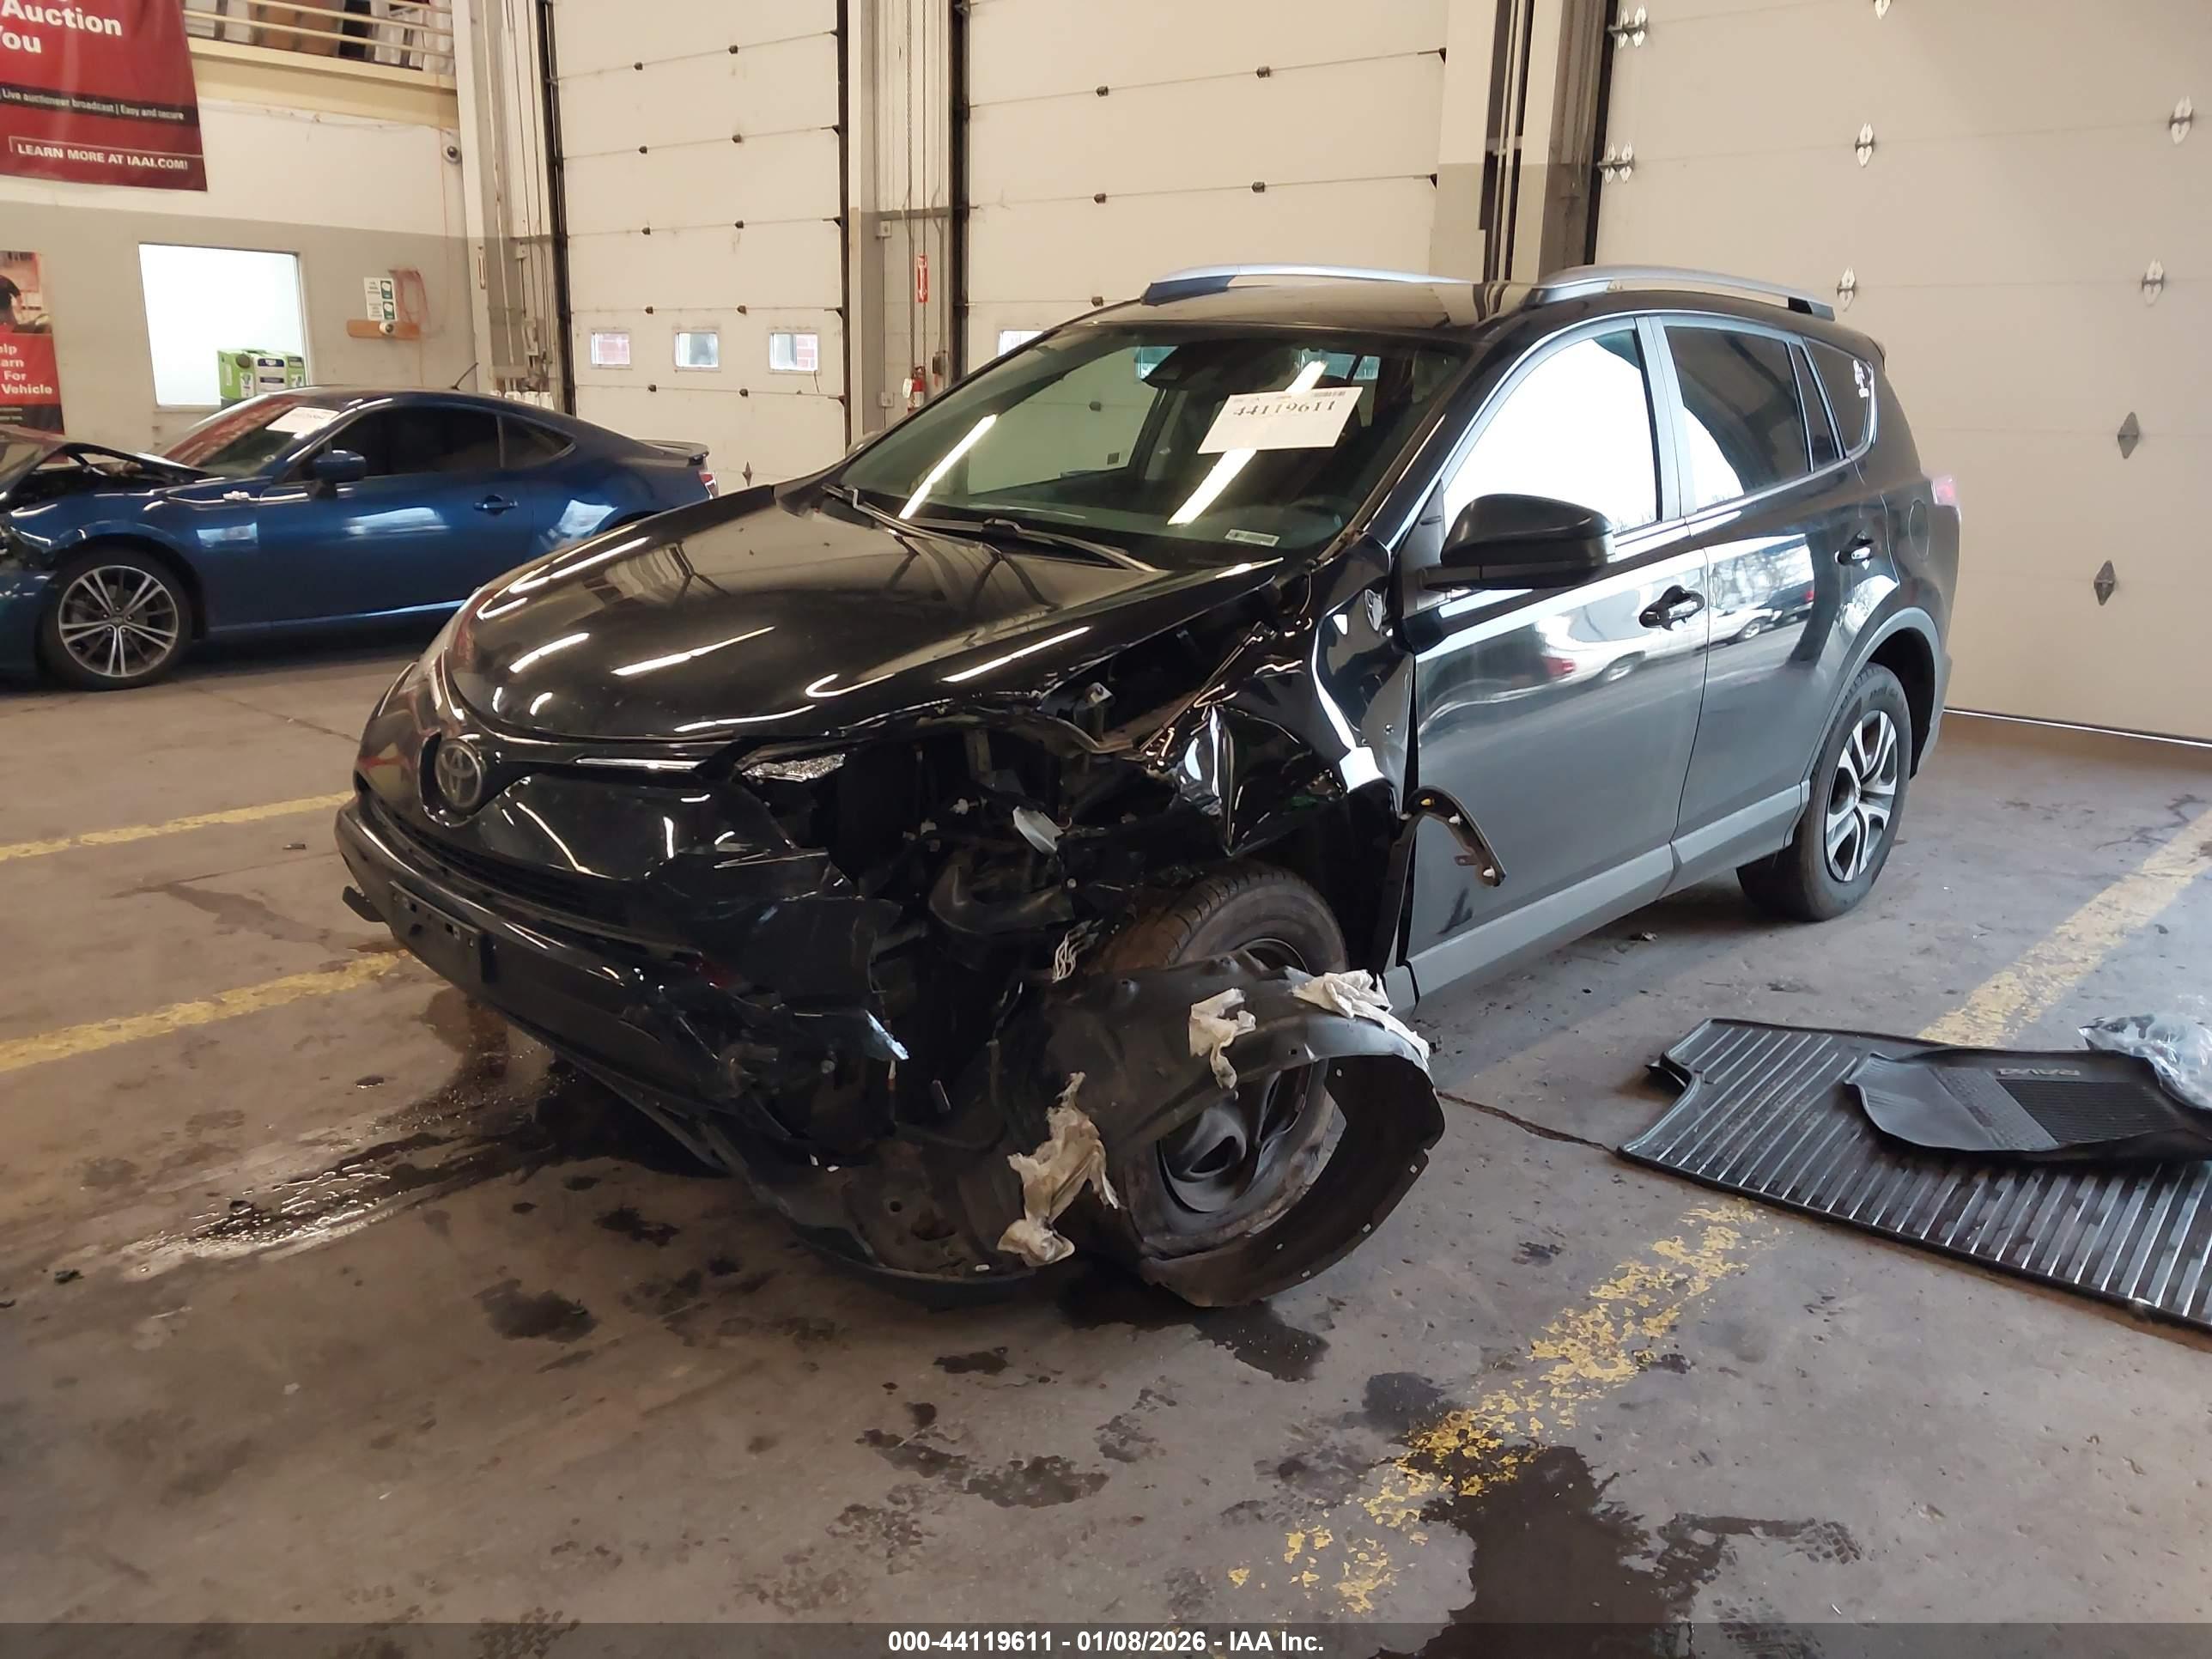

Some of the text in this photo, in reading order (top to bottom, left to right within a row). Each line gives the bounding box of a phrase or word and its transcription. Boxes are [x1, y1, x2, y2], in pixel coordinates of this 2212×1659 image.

[1, 0, 122, 36] Auction
[2, 88, 21, 100] Live
[72, 98, 114, 113] broadcast
[142, 108, 157, 118] and
[18, 143, 188, 170] LEARN MORE AT IAAI.COM!
[4, 370, 27, 380] For
[1, 384, 52, 394] Vehicle
[1233, 401, 1335, 416] 44119611
